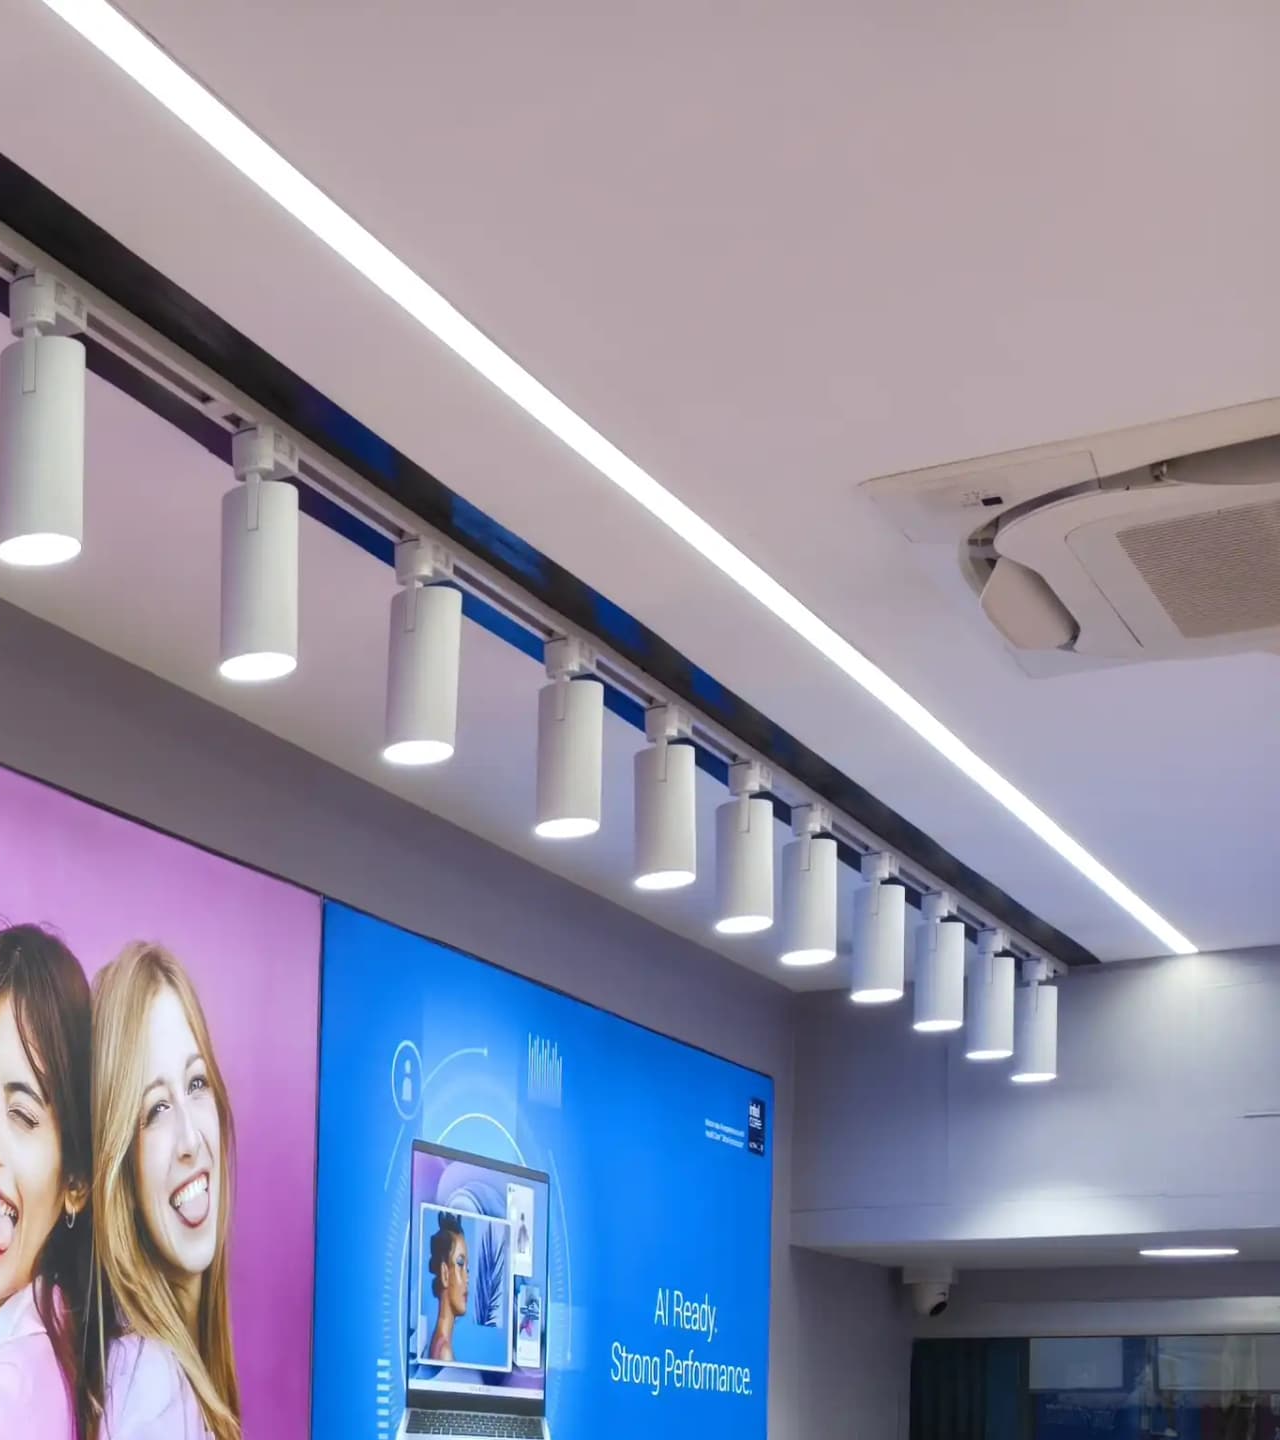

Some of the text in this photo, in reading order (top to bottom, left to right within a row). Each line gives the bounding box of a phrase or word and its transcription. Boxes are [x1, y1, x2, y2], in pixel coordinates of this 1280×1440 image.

[654, 1287, 718, 1343] AI Ready.
[610, 1341, 753, 1396] Strong Performance.
